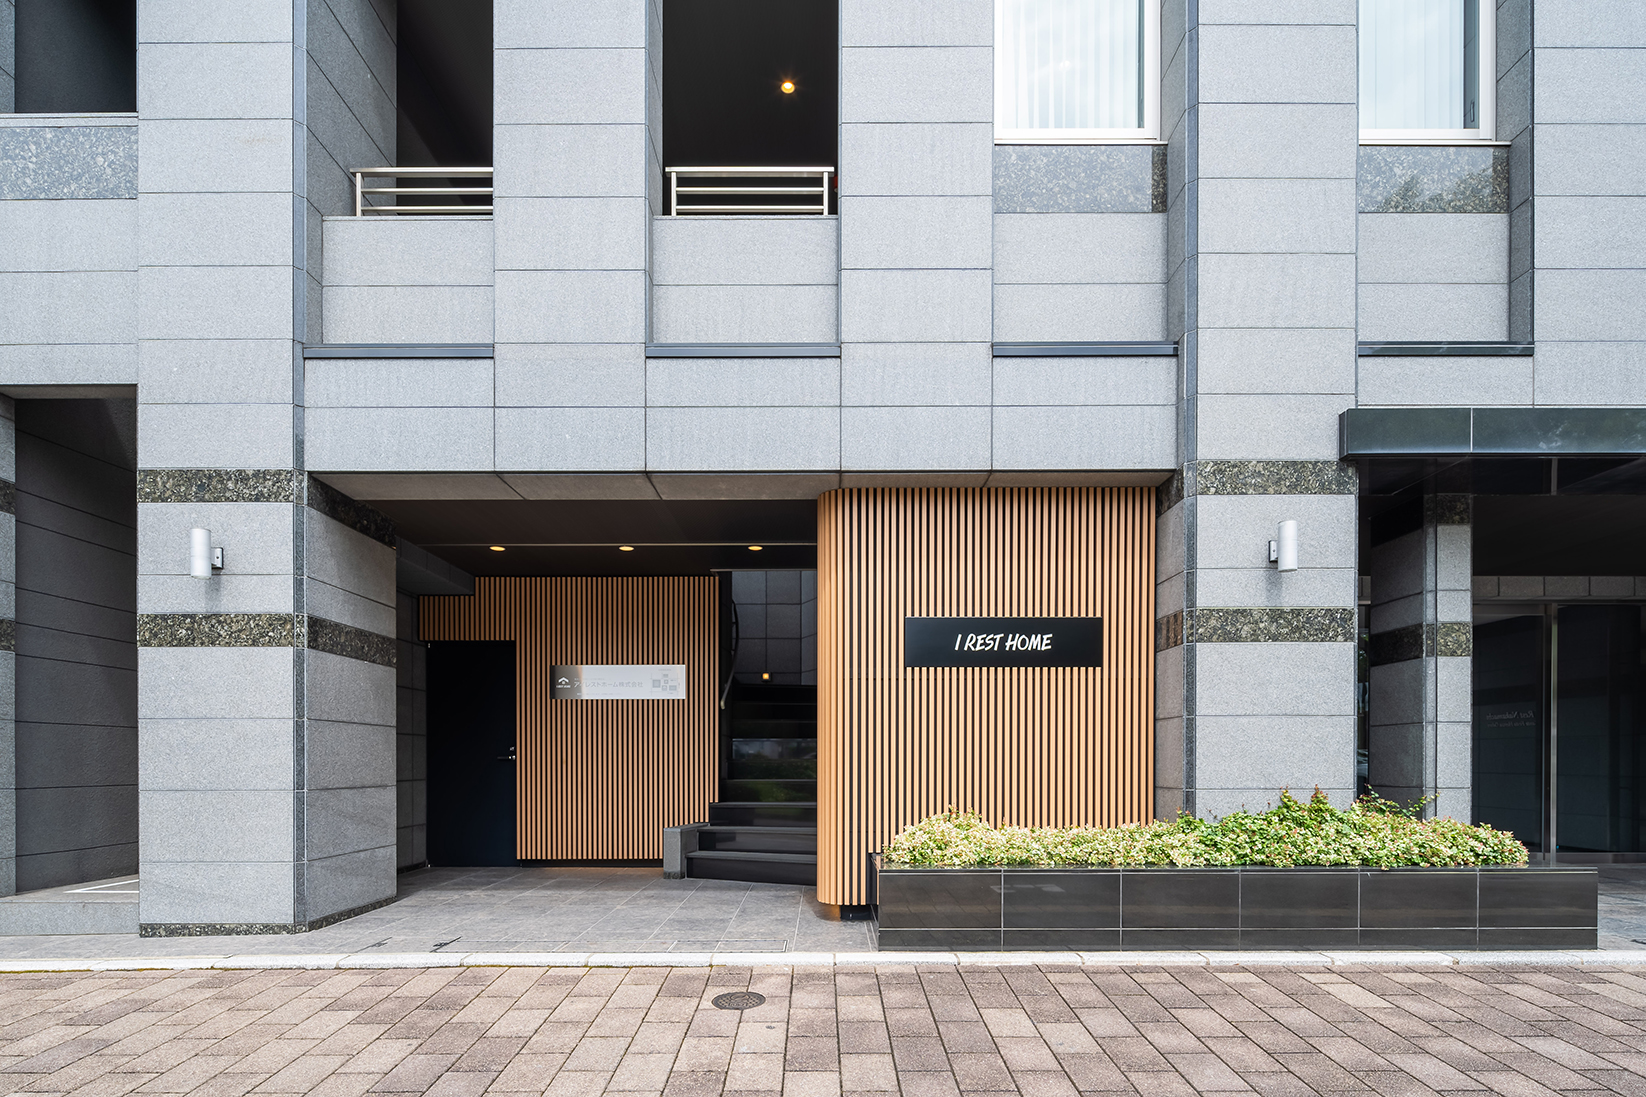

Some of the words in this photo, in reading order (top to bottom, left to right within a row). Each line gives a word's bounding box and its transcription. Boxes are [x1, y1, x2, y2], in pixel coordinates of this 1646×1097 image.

[954, 633, 962, 651] I
[963, 633, 1004, 651] REST
[1005, 633, 1053, 651] HOME
